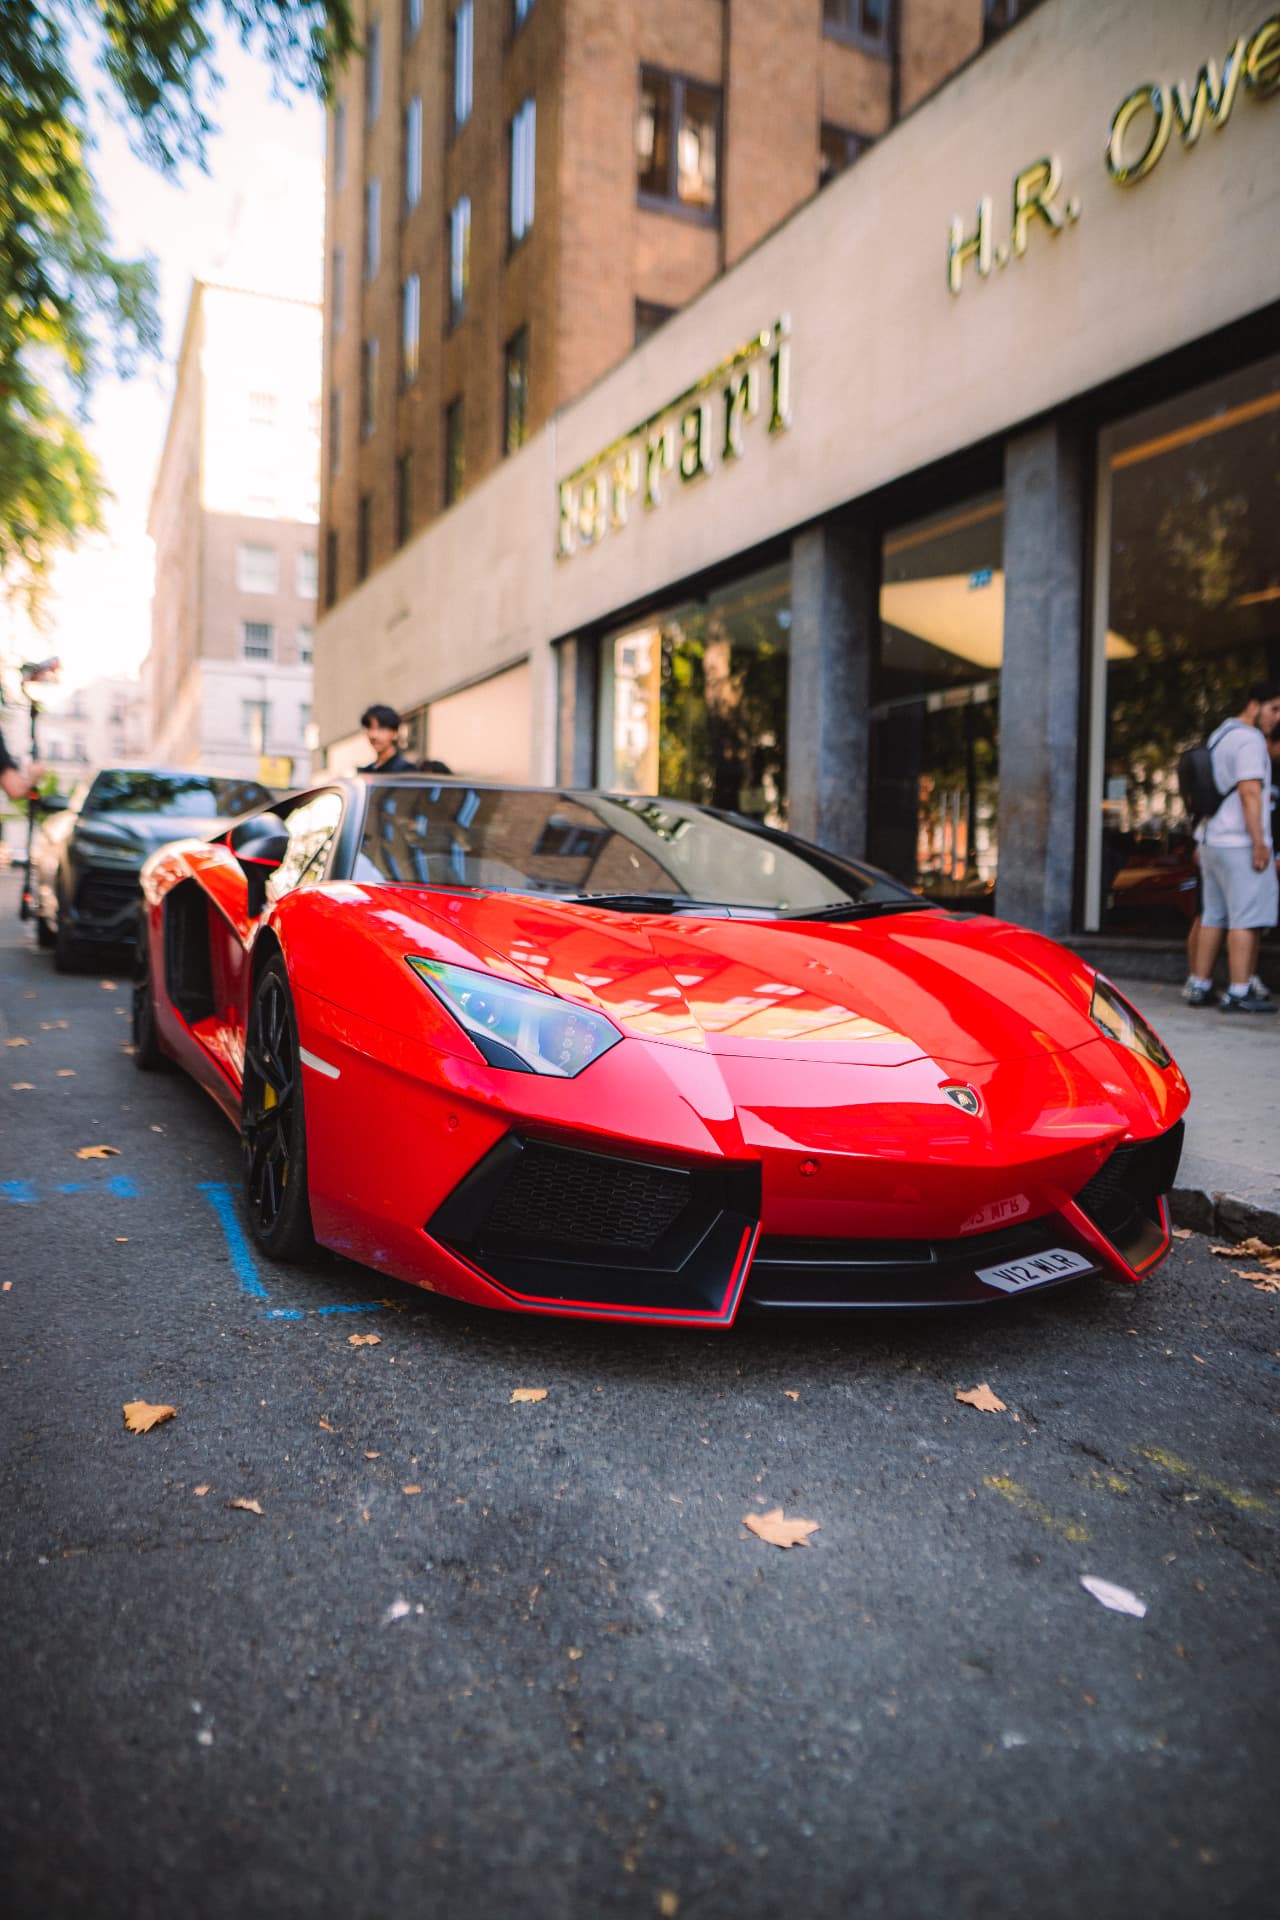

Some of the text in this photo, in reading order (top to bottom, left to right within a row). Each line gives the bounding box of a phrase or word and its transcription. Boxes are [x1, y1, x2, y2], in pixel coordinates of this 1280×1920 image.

[949, 155, 1080, 294] H.R.
[992, 1254, 1079, 1285] V12 WLR
